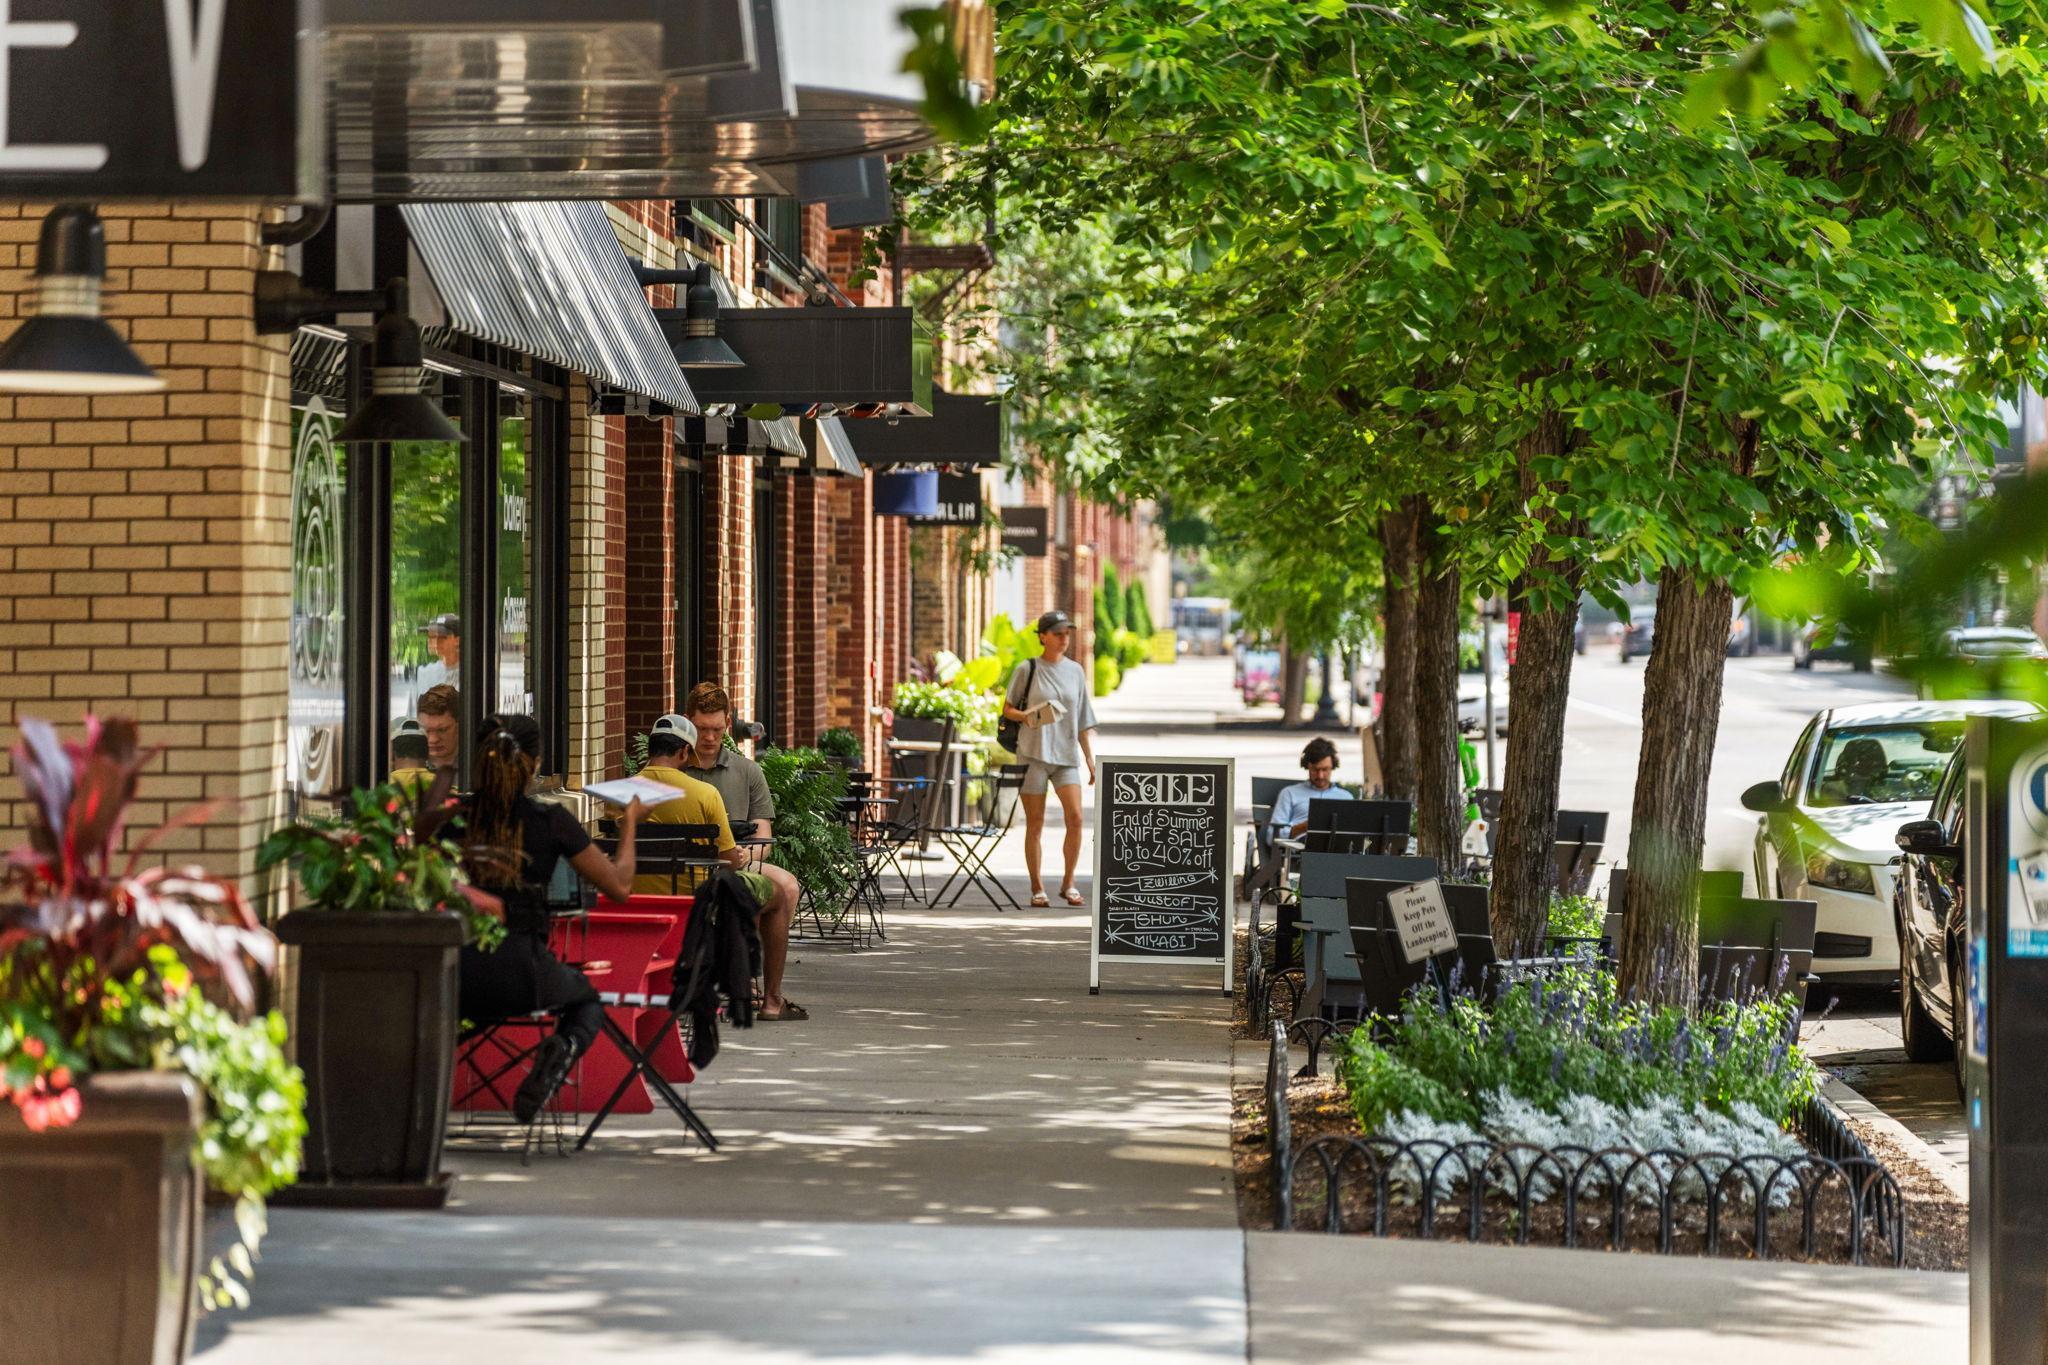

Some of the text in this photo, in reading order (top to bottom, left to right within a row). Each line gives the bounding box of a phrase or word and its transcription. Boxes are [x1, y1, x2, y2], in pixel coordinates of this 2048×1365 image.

[1112, 808, 1214, 831] End of Summer
[1113, 826, 1215, 848] KNIFE SALE
[1113, 843, 1213, 869] Up to 40% off
[1405, 896, 1426, 908] Please
[1403, 905, 1437, 923] Keep Pets
[1411, 920, 1436, 934] Off the
[1134, 934, 1187, 949] MIYABI
